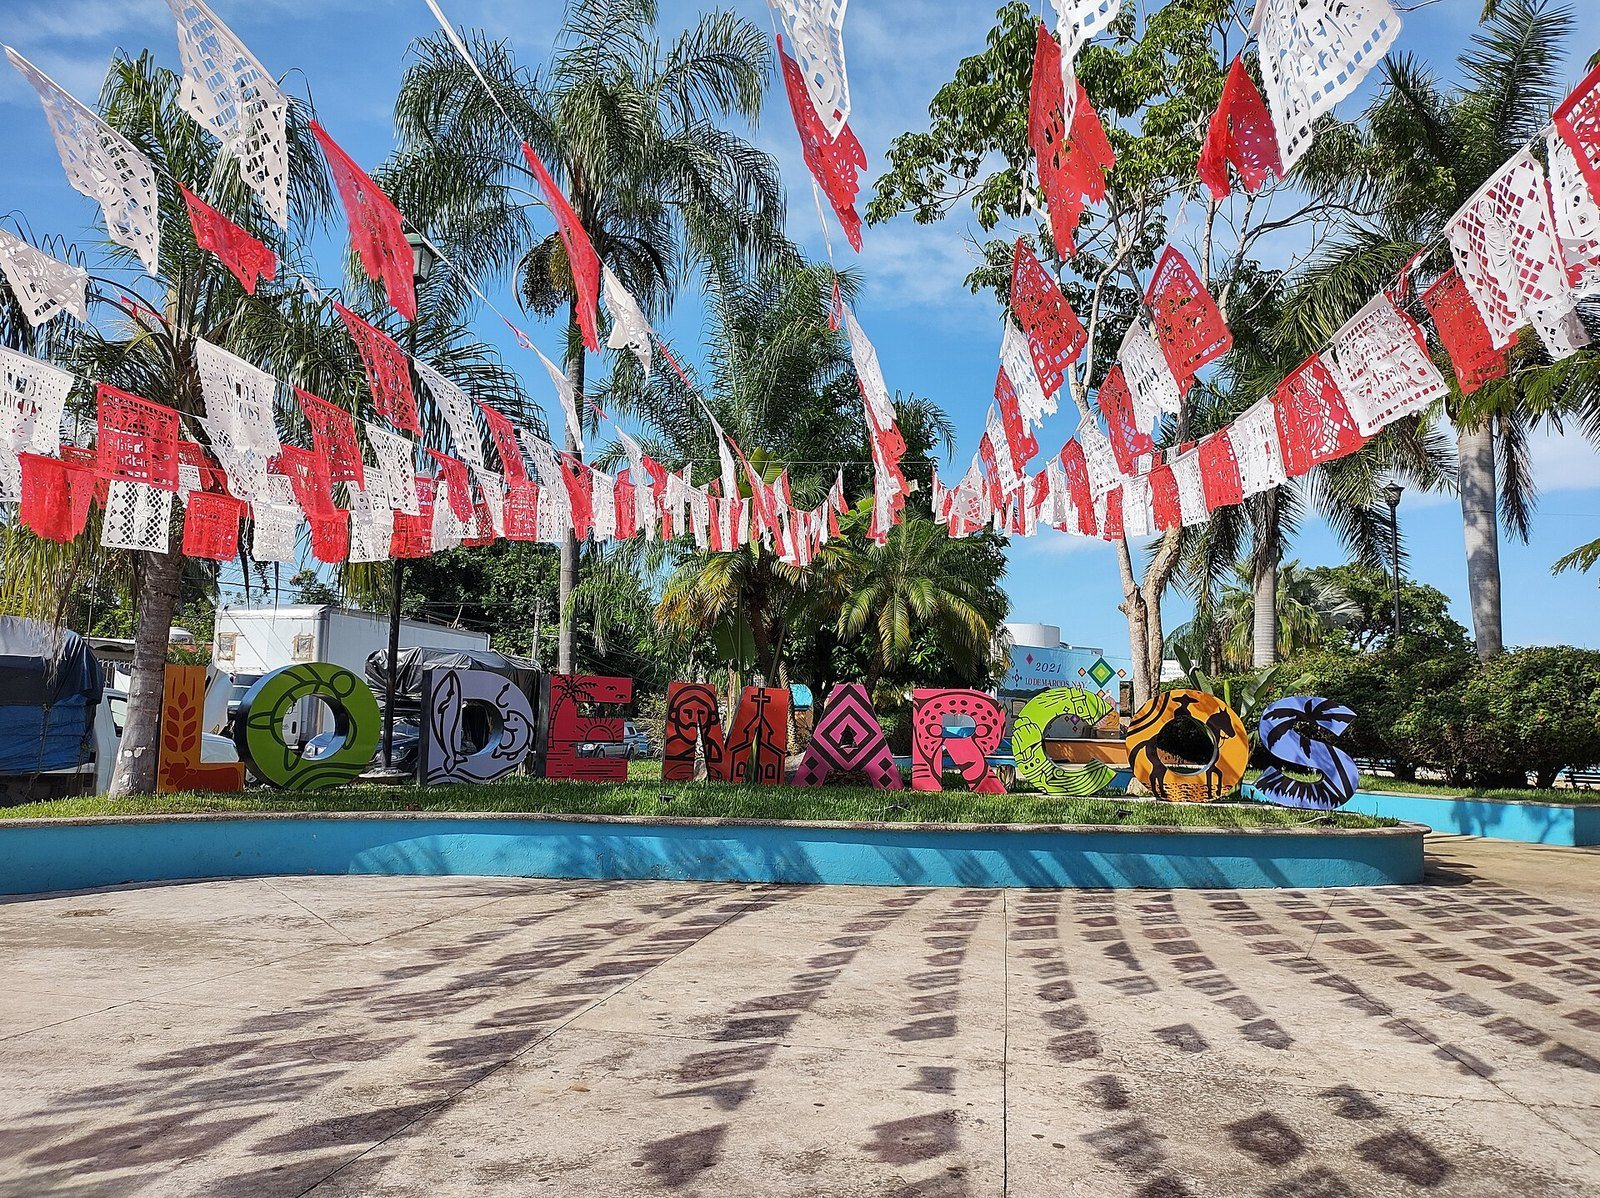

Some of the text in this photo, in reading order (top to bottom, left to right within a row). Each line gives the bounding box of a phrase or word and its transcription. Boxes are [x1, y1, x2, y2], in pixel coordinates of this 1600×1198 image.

[1034, 662, 1062, 674] 2021
[1042, 678, 1069, 688] MARCOS
[157, 662, 1357, 810] LO DE MARCOS
